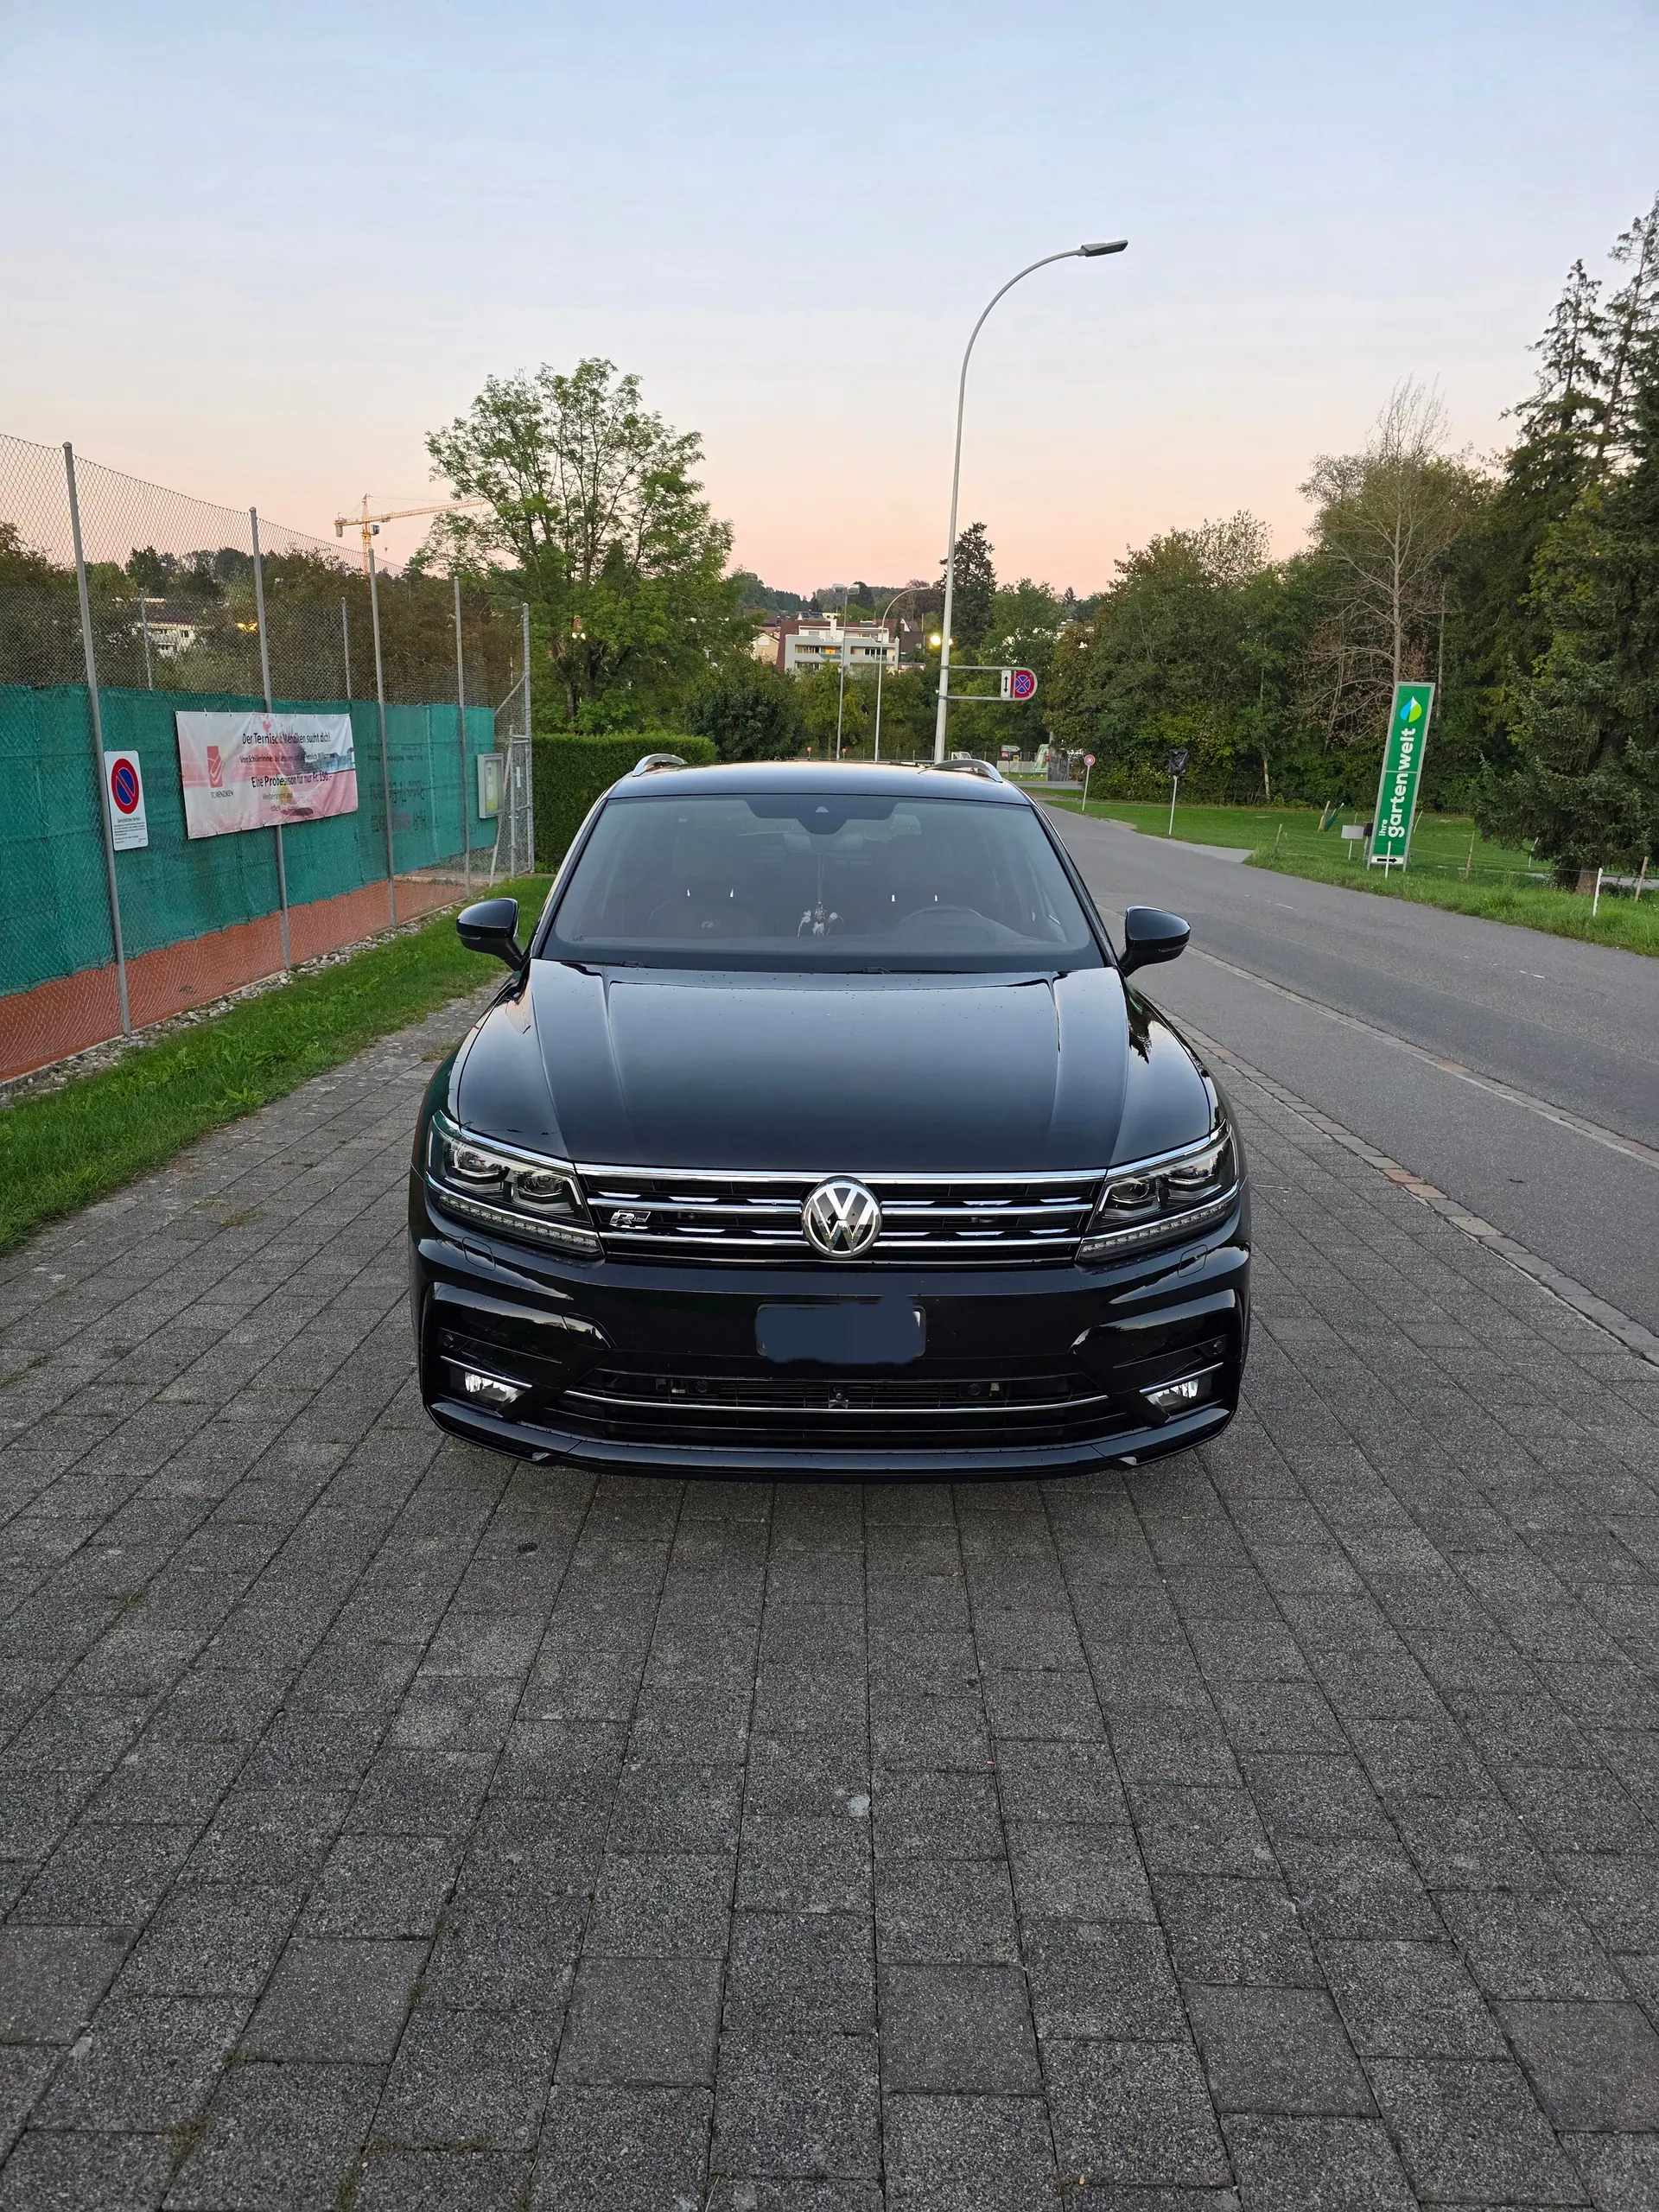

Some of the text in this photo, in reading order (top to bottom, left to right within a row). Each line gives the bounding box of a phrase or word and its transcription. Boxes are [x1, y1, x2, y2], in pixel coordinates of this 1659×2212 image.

[242, 733, 252, 744] Der
[307, 732, 320, 743] sucht
[251, 776, 264, 788] Eine
[1388, 728, 1416, 838] gartenwelt
[1378, 819, 1388, 836] ihre
[804, 1183, 879, 1255] VW
